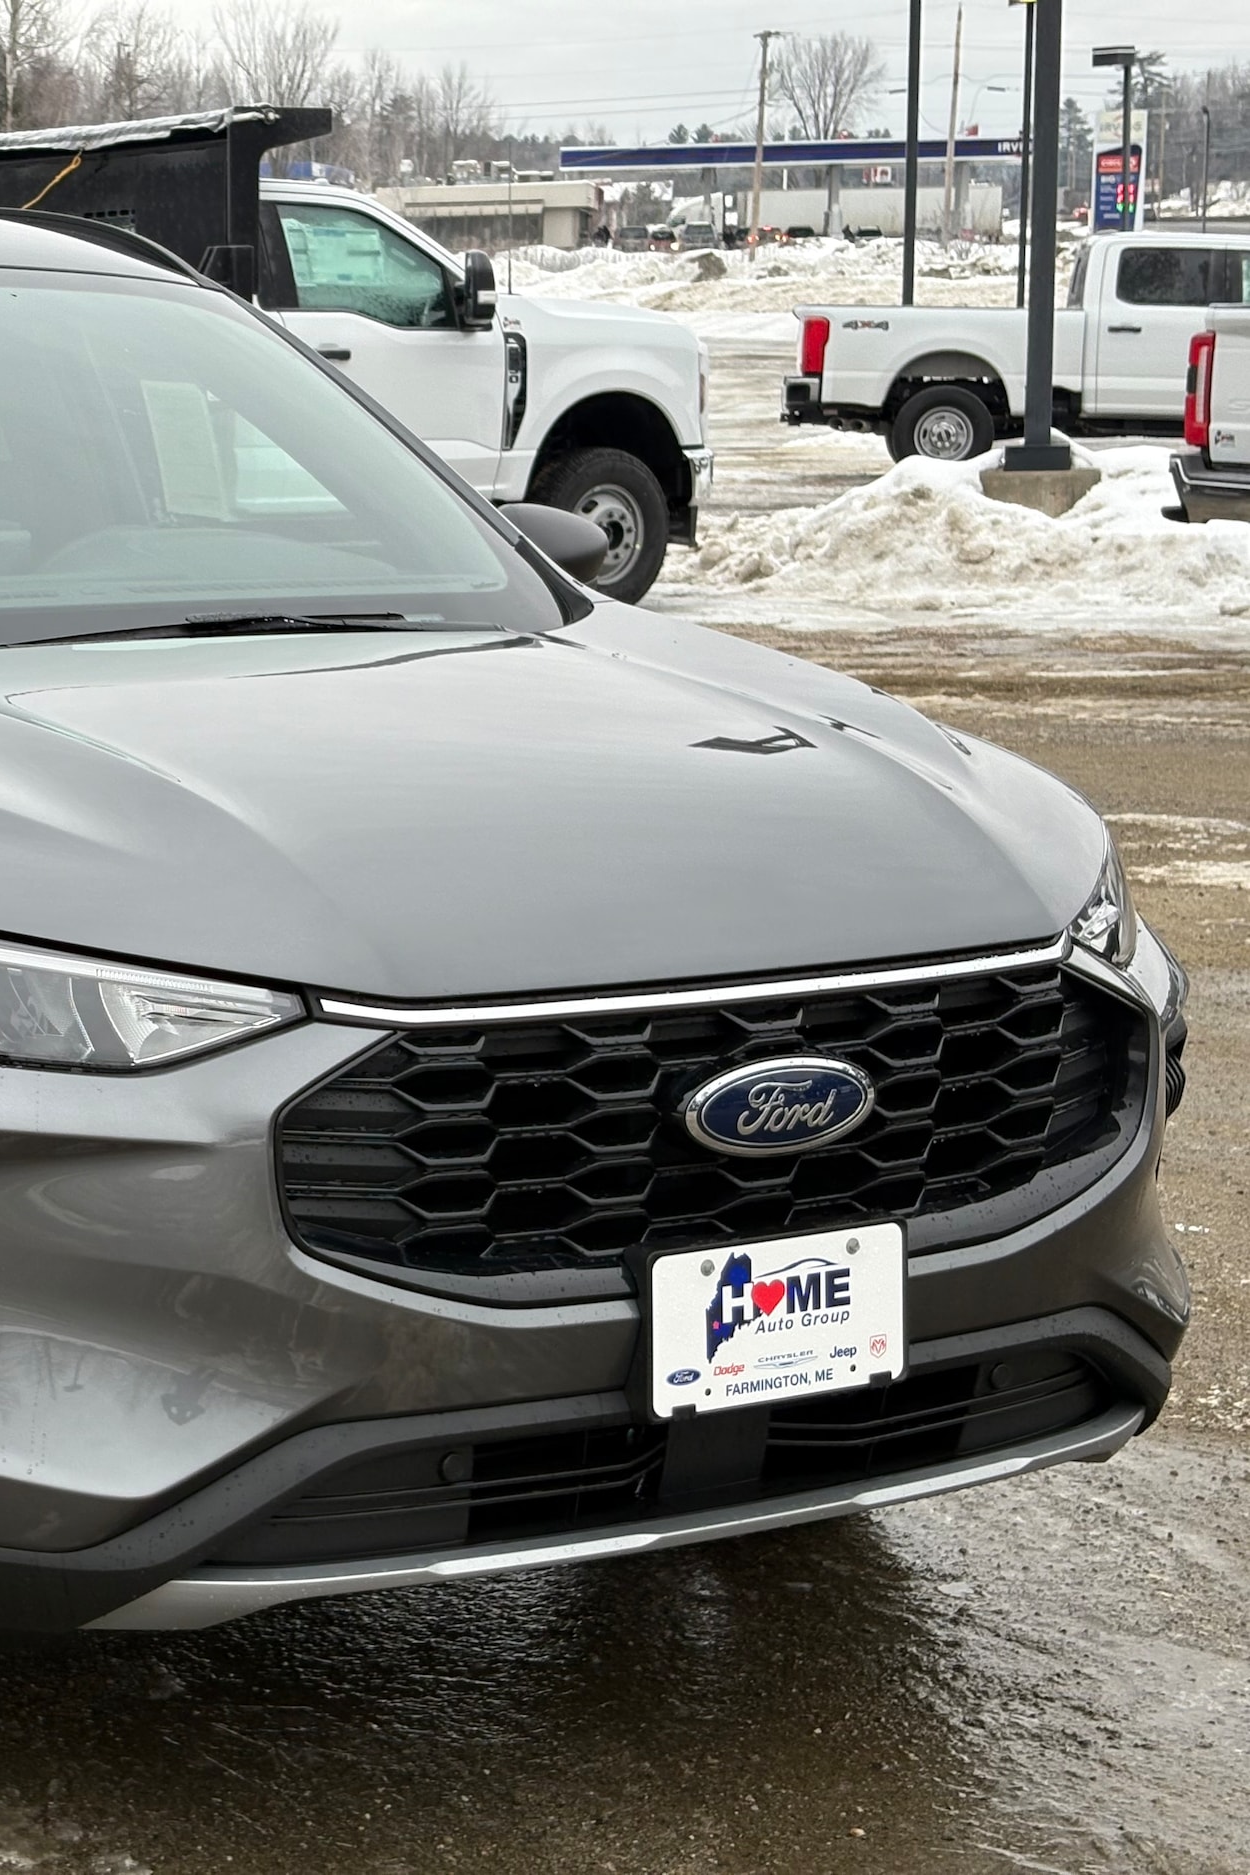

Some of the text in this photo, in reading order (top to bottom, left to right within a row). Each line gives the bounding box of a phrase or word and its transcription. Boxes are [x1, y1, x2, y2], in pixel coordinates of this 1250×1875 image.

[736, 1079, 837, 1136] Ford
[754, 1309, 851, 1335] Auto Group
[757, 1349, 814, 1363] CHRYSLER
[829, 1344, 857, 1360] Jeep
[713, 1362, 746, 1377] Dodge
[726, 1368, 834, 1398] FARMINGTON, ME
